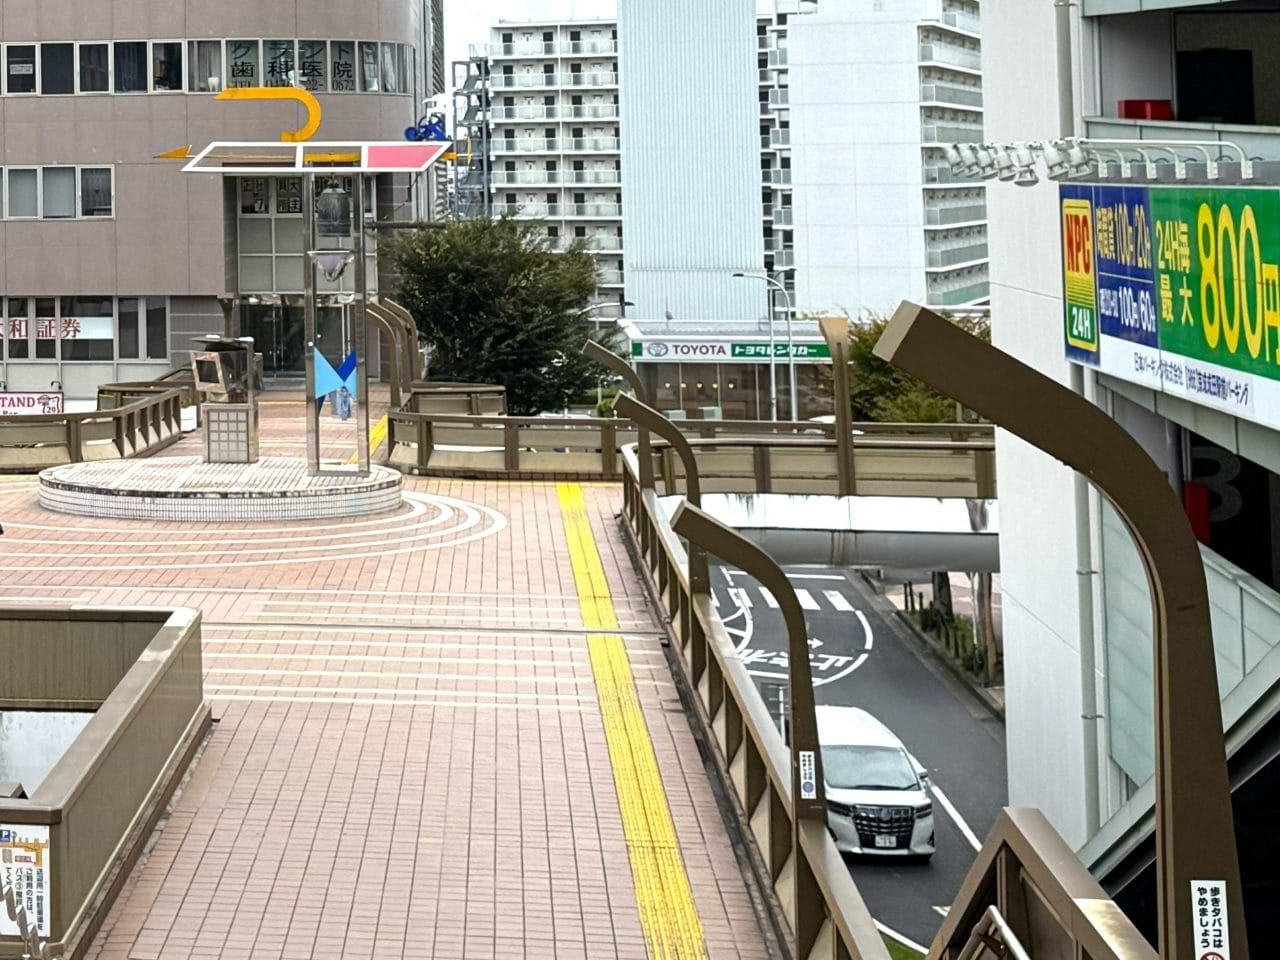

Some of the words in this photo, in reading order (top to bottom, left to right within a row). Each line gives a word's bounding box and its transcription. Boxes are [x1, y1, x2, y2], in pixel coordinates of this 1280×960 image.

[230, 61, 353, 79] 歯科医院
[1065, 213, 1091, 275] NPC
[1072, 305, 1091, 339] 24H
[1160, 274, 1194, 328] 最大
[672, 344, 726, 355] TOYOTA
[734, 346, 817, 356] トヨタレンタカー
[1197, 887, 1210, 948] やめましょう
[1210, 887, 1223, 948] 歩きタバコは
